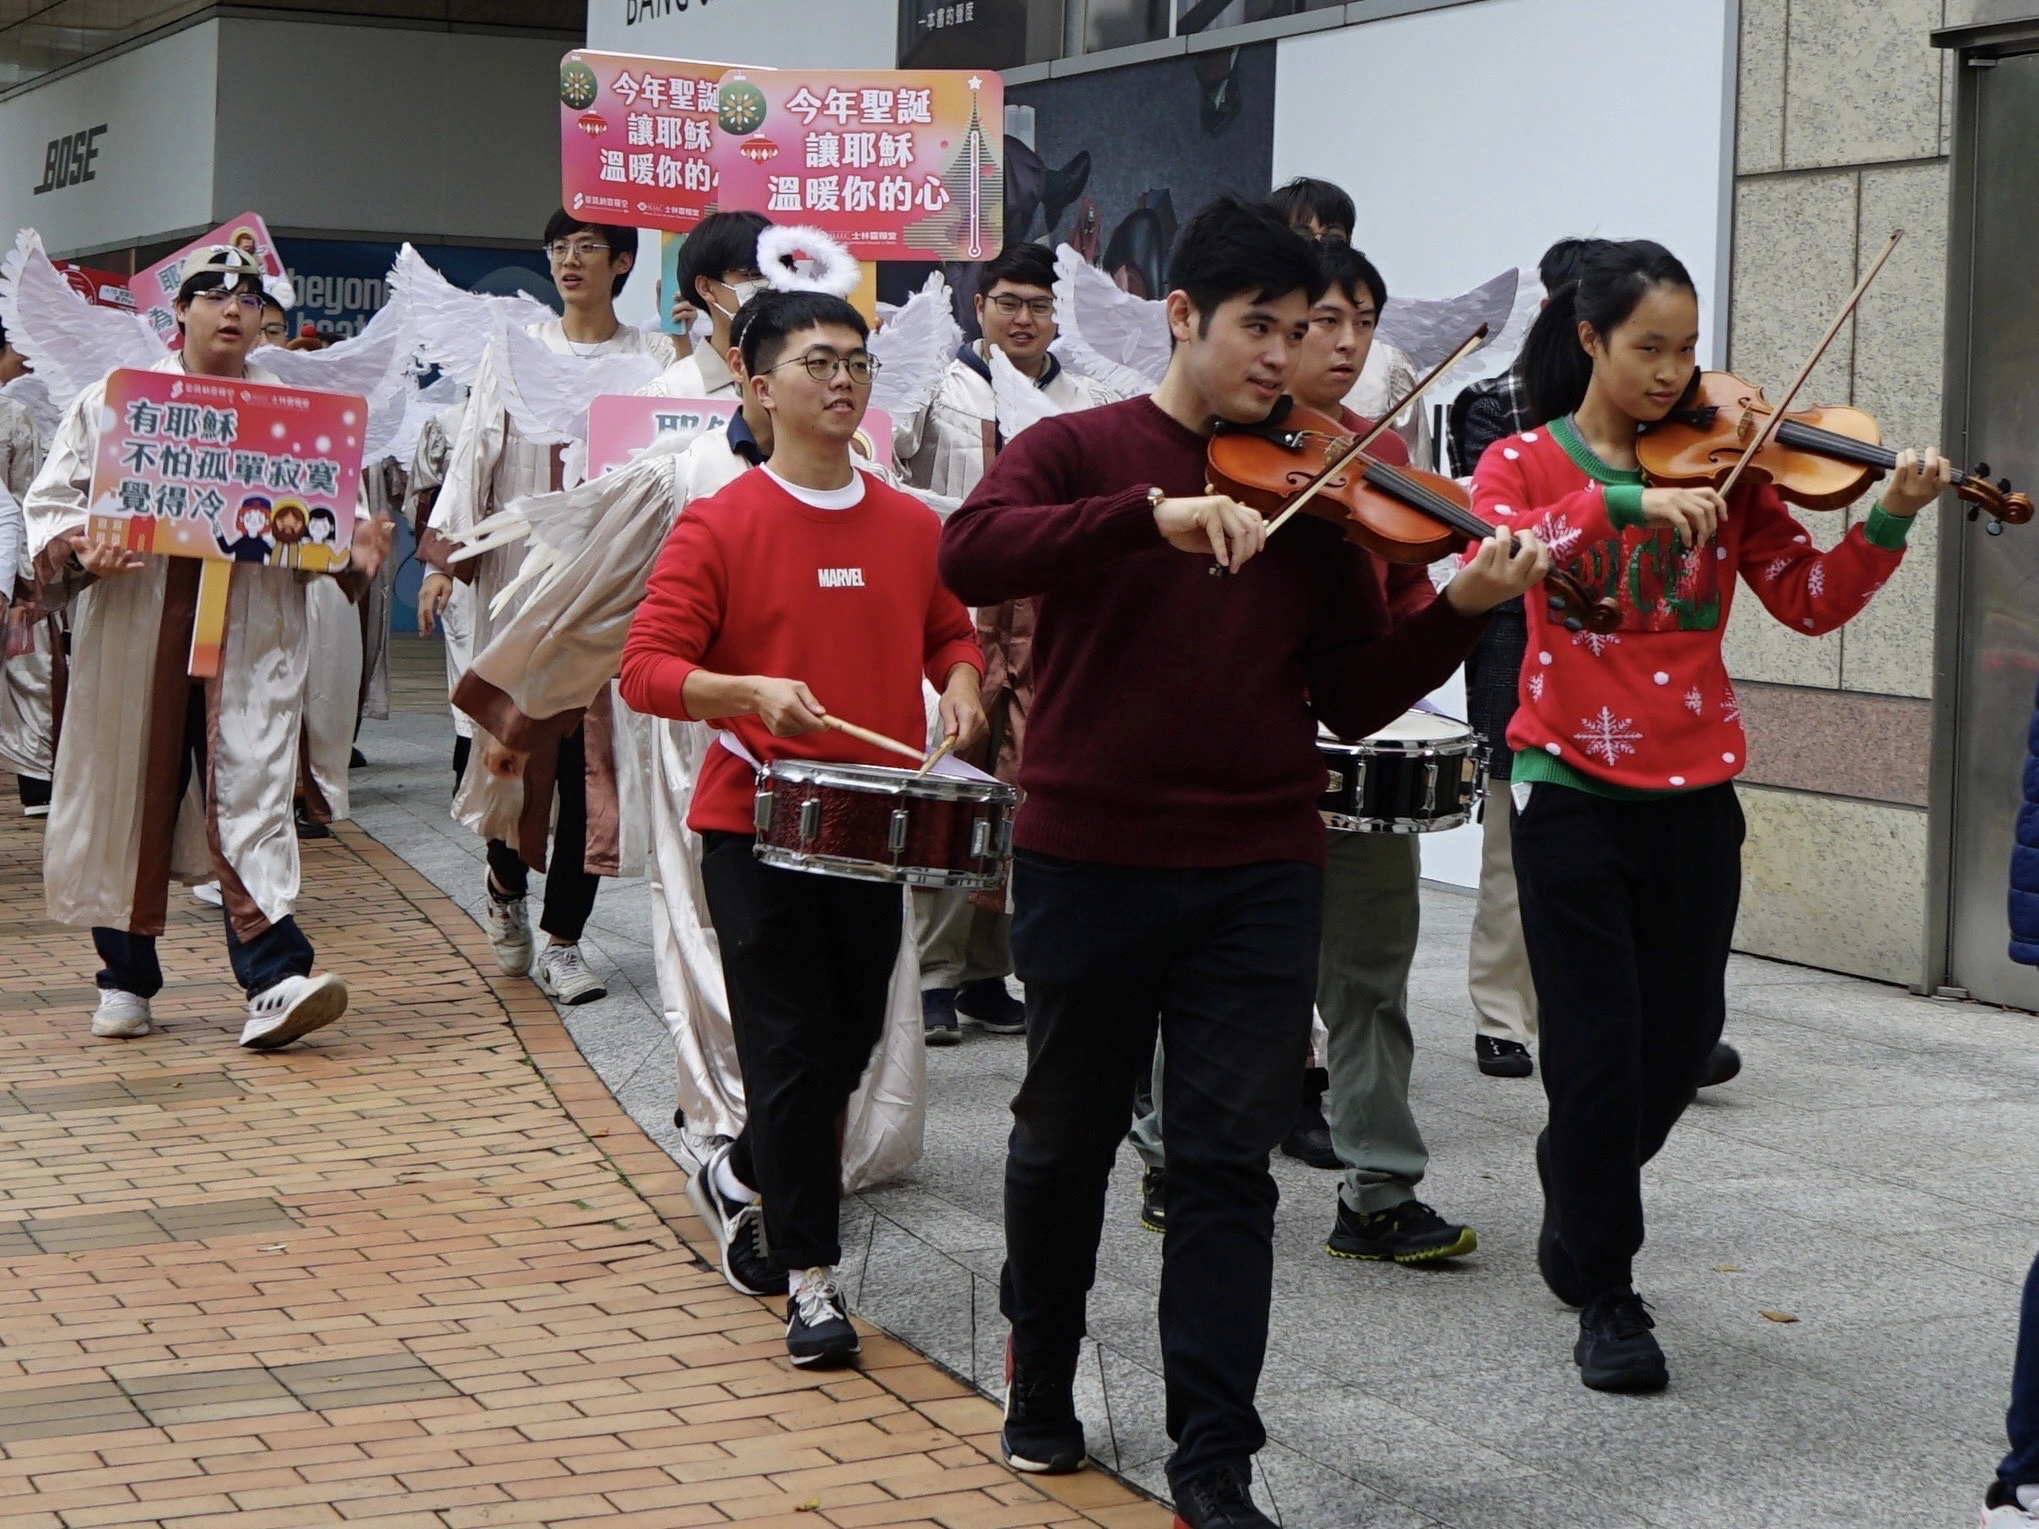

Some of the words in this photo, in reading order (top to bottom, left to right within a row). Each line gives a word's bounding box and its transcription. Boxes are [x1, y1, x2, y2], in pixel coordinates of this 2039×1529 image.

[785, 87, 933, 126] 今年聖誕
[627, 112, 712, 153] 讓耶穌
[804, 131, 914, 169] 讓耶穌
[33, 123, 108, 196] BOSE
[599, 148, 720, 193] 溫暖你的
[766, 174, 951, 212] 溫暖你的心
[126, 399, 238, 444] 有耶穌
[121, 439, 341, 495] 不怕孤單寂寞
[117, 481, 227, 522] 覺得冷
[817, 568, 866, 588] MARVEL
